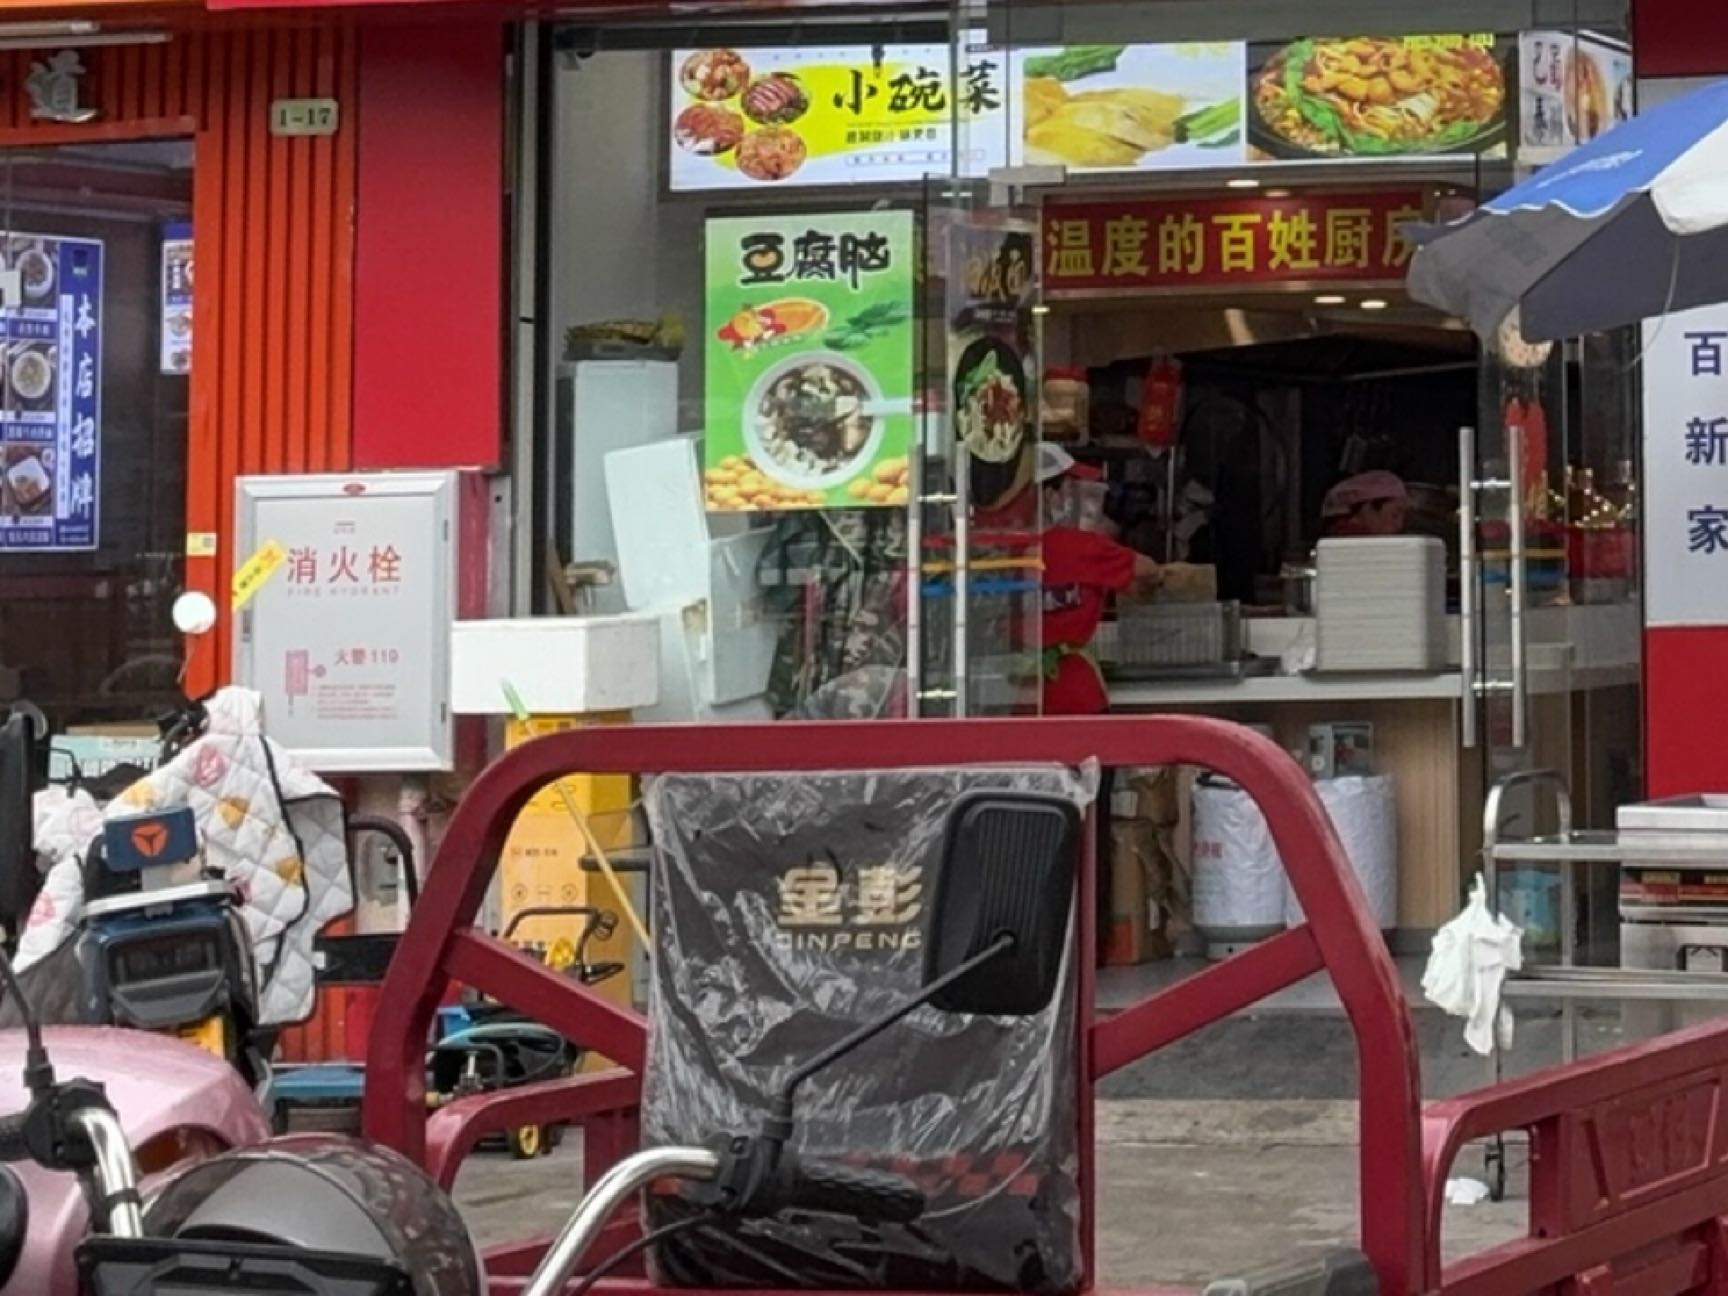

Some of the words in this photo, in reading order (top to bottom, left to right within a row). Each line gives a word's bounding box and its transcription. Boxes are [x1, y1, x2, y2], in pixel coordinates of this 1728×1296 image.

[832, 59, 1001, 115] 小碗菜
[280, 107, 332, 129] 1-17
[740, 229, 891, 290] 豆腐脑
[287, 544, 402, 585] 消火栓
[776, 864, 923, 925] 金彭
[775, 930, 922, 951] JINPENG
